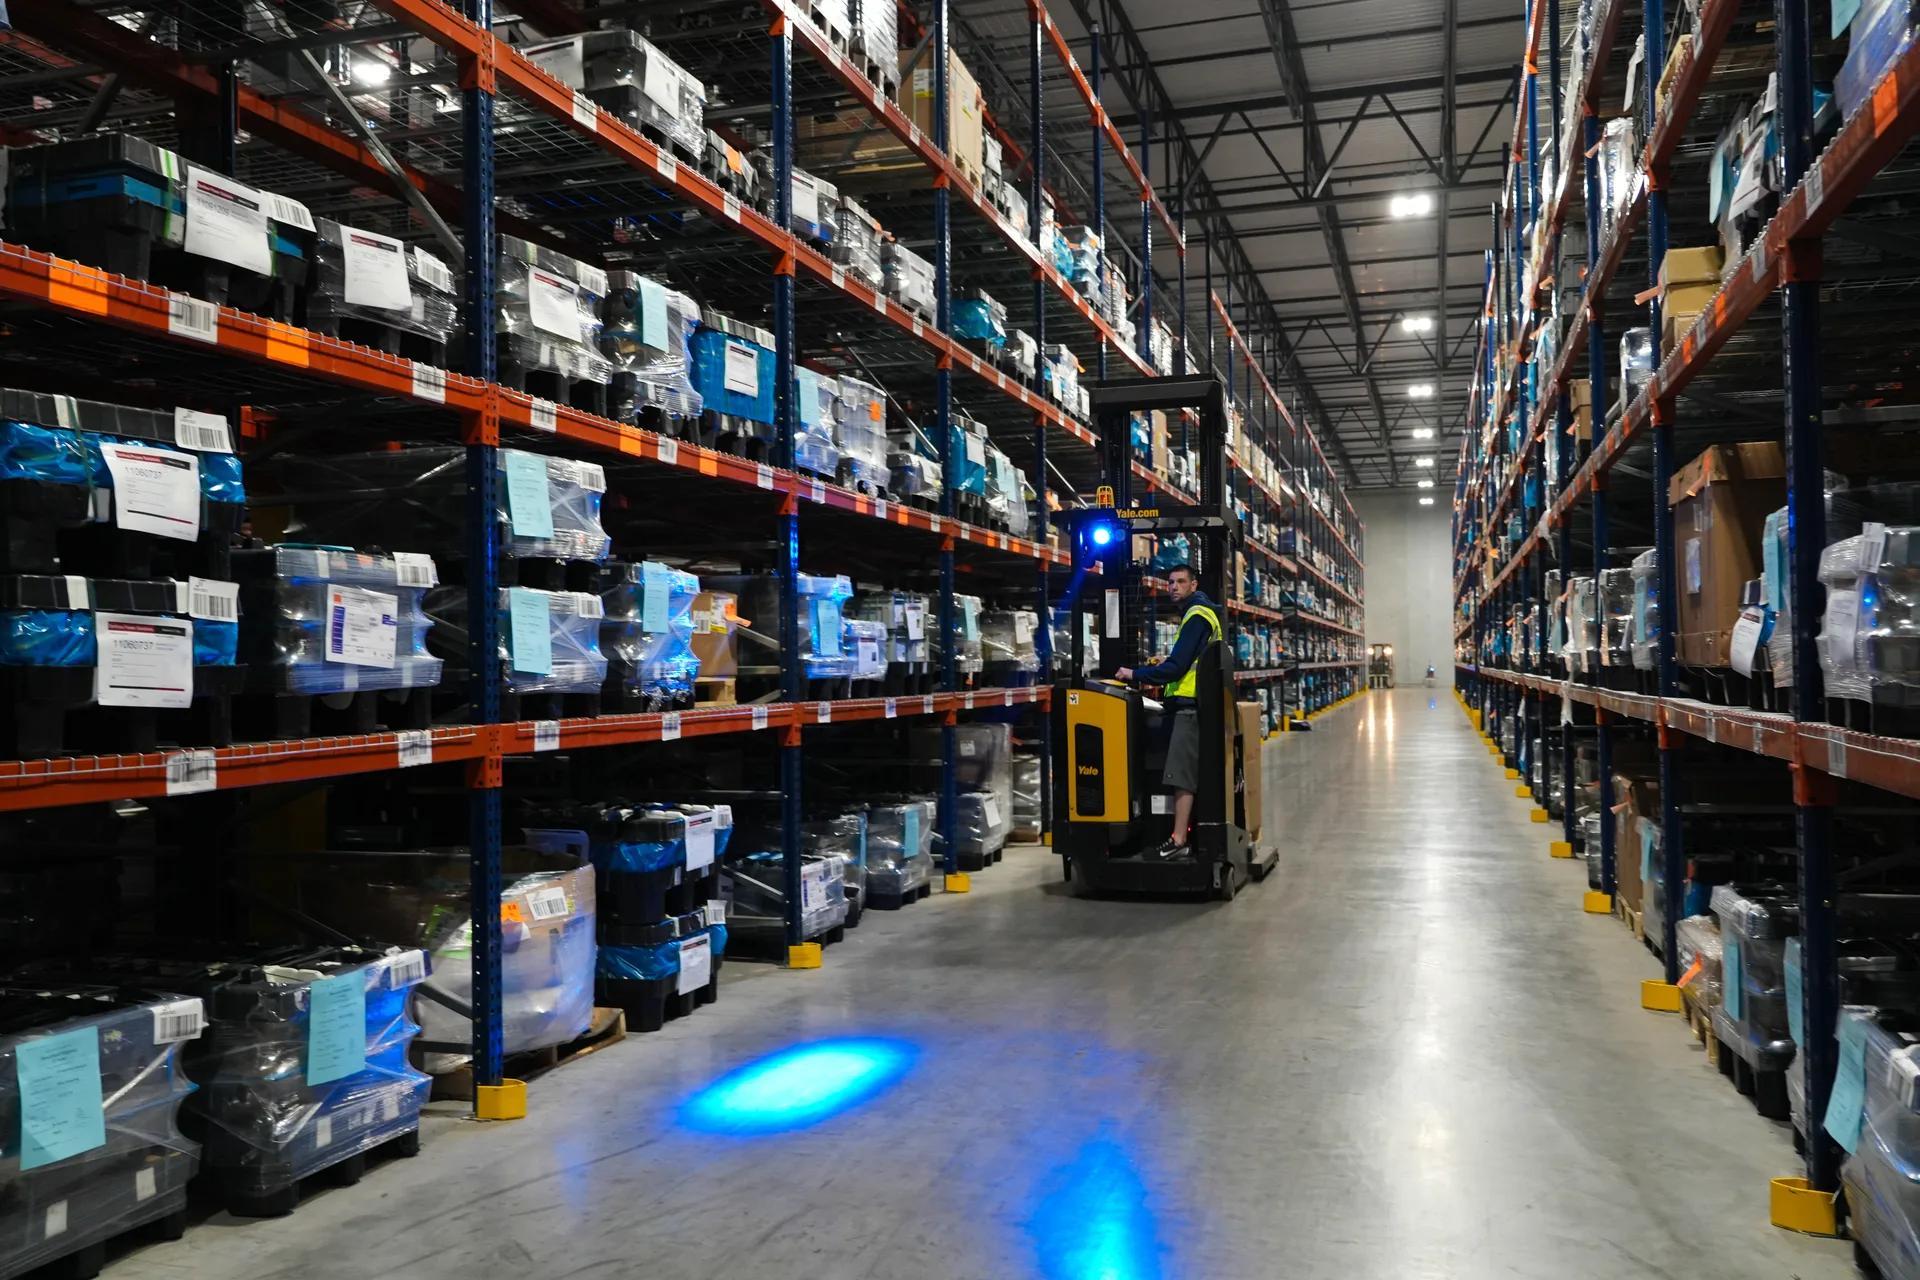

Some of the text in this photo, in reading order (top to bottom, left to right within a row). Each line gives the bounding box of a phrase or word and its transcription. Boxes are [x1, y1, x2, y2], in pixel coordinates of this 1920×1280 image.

[1116, 508, 1159, 518] Yale.com
[114, 639, 153, 650] 11060737
[1078, 766, 1099, 776] Yale
